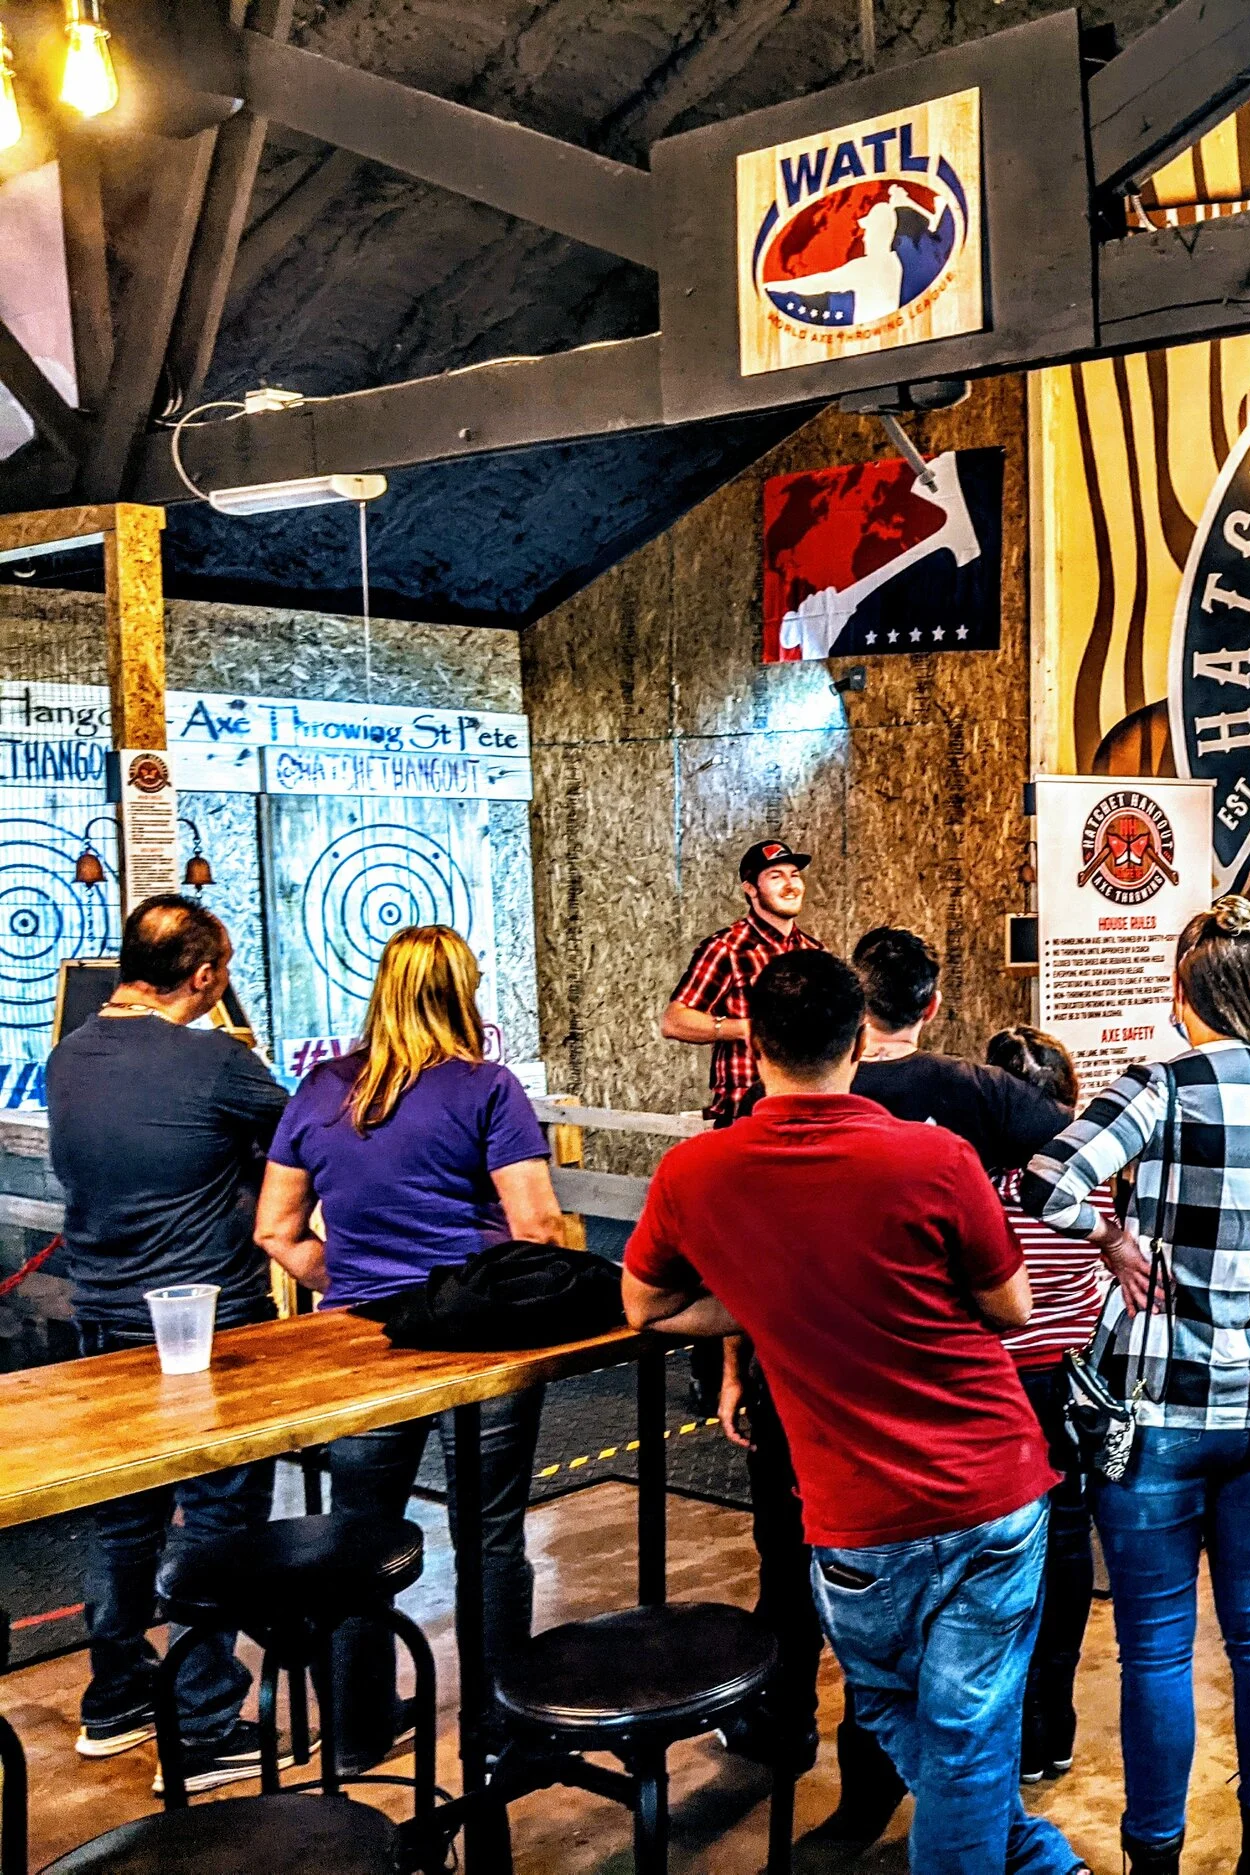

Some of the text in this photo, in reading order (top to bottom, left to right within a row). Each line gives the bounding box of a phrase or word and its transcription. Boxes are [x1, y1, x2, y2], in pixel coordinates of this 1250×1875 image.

[780, 123, 929, 207] WATL
[811, 331, 833, 344] AXE
[837, 316, 904, 343] THROWING
[909, 271, 956, 318] LEAGUE
[180, 700, 250, 741] Axe
[257, 704, 404, 751] Throwing
[409, 714, 452, 749] St
[457, 715, 518, 751] Pete
[1101, 1026, 1155, 1043] AXE SAFETY
